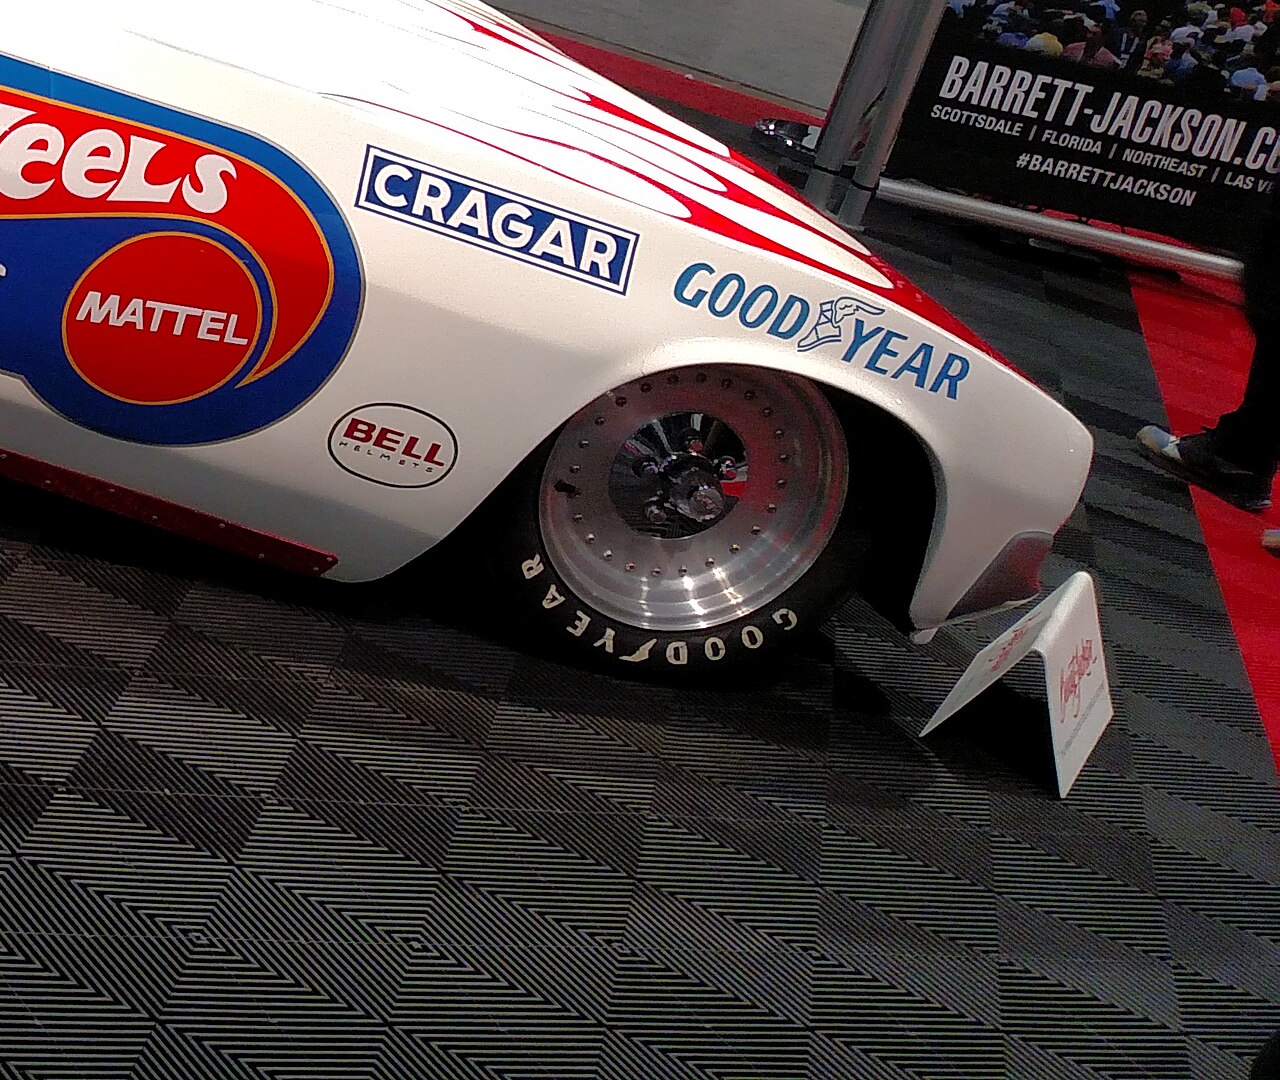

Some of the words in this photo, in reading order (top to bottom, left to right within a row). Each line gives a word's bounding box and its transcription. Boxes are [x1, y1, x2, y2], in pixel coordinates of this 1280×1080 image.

[930, 104, 1024, 136] SCOTTSDALE
[1041, 129, 1103, 154] FLORIDA
[1122, 148, 1208, 179] NORTHEAST
[1224, 171, 1255, 193] LAS
[1016, 153, 1198, 207] #BARRETTJACKSON
[374, 162, 619, 280] CRAGAR
[75, 291, 248, 346] MATTEL
[339, 441, 434, 473] HELMETS
[343, 417, 445, 467] BELL
